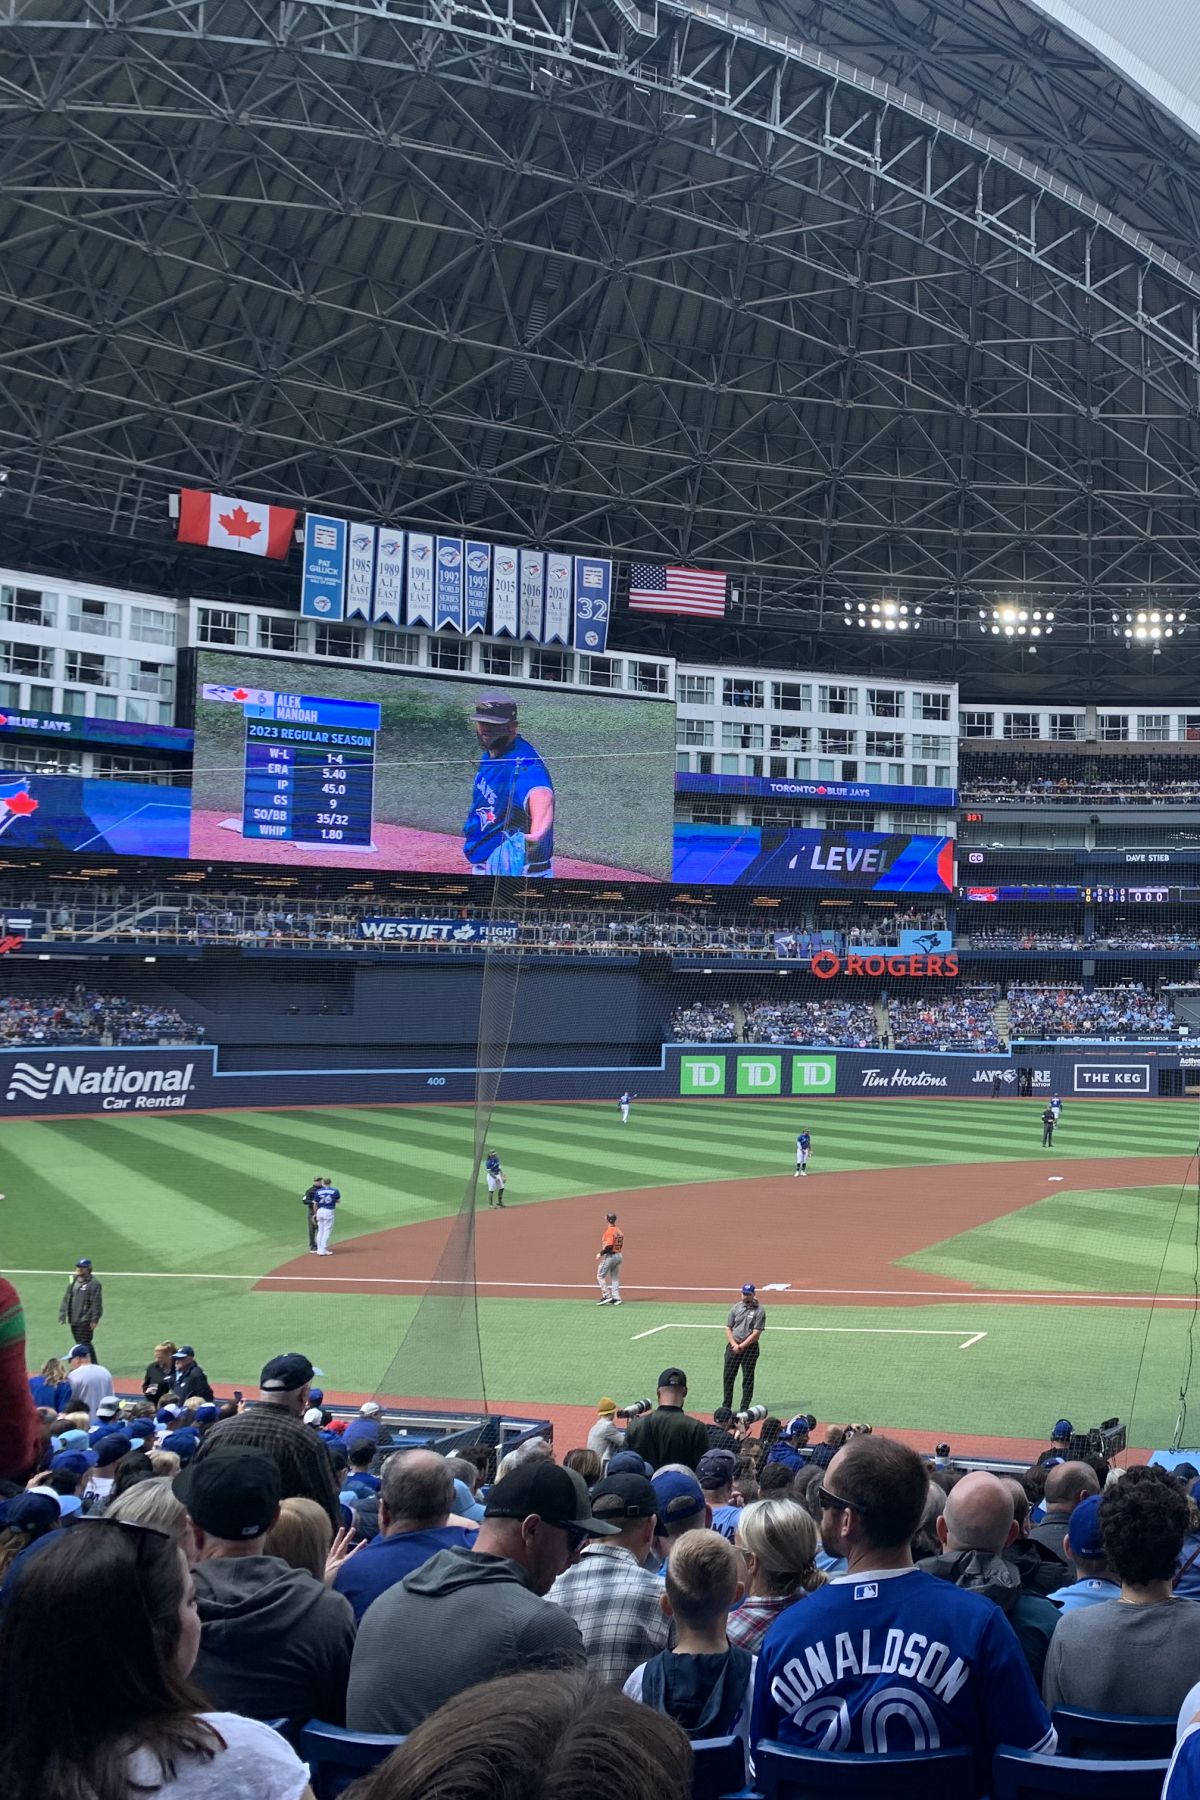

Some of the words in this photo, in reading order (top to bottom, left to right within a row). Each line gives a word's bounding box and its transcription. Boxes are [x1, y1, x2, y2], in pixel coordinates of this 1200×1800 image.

[309, 565, 338, 575] GILLICK
[351, 558, 371, 573] 1985
[379, 562, 400, 577] 1989
[411, 567, 430, 580] 1991
[439, 569, 460, 584] 1992
[350, 584, 369, 596] EAST
[439, 585, 460, 594] WORLD
[468, 575, 488, 590] 1993
[496, 579, 515, 593] 2015
[522, 583, 541, 597] 2016
[378, 589, 398, 600] EAST
[410, 592, 431, 603] EAST
[439, 594, 459, 603] SERIES
[549, 586, 569, 599] 2020
[439, 603, 460, 613] CHAMPS
[577, 597, 608, 623] 32
[258, 693, 267, 704] 6
[277, 695, 302, 708] ALEK
[258, 707, 266, 716] P
[276, 707, 318, 722] MANOAH
[8, 716, 39, 729] BLUE
[40, 719, 71, 732] JAYS
[250, 725, 278, 737] 2023
[281, 728, 329, 743] REGULAR
[331, 733, 372, 747] SEASON
[269, 748, 290, 760] W-L
[327, 753, 343, 764] 1-4
[268, 764, 289, 775] ERA
[322, 768, 347, 779] 5.40
[277, 780, 288, 790] IP
[321, 784, 346, 795] 45.0
[770, 783, 817, 795] TORONTO
[827, 786, 848, 796] BLUE
[849, 787, 870, 798] JAYS
[273, 795, 288, 805] GS
[329, 799, 338, 809] 9
[253, 809, 287, 821] SO/BB
[316, 813, 349, 826] 35/32
[259, 825, 287, 836] WHIP
[321, 829, 343, 840] 1.80
[811, 845, 891, 873] LEVEL
[970, 854, 982, 862] CC
[1126, 854, 1146, 862] DAVE
[1148, 854, 1170, 862] STIEB
[360, 922, 453, 940] WESTJET
[479, 926, 518, 939] FLIGHT
[848, 954, 959, 977] ROGERS
[52, 1063, 193, 1095] National
[427, 1077, 446, 1086] 400
[685, 1062, 721, 1087] TD
[741, 1062, 776, 1086] TD
[797, 1062, 832, 1086] TD
[861, 1069, 889, 1087] Tim
[890, 1068, 948, 1087] Hortons
[1083, 1073, 1110, 1083] THE
[1114, 1073, 1141, 1084] KEG
[103, 1097, 131, 1110] Car
[135, 1094, 186, 1109] Rental
[770, 1629, 970, 1714] DONALDSON
